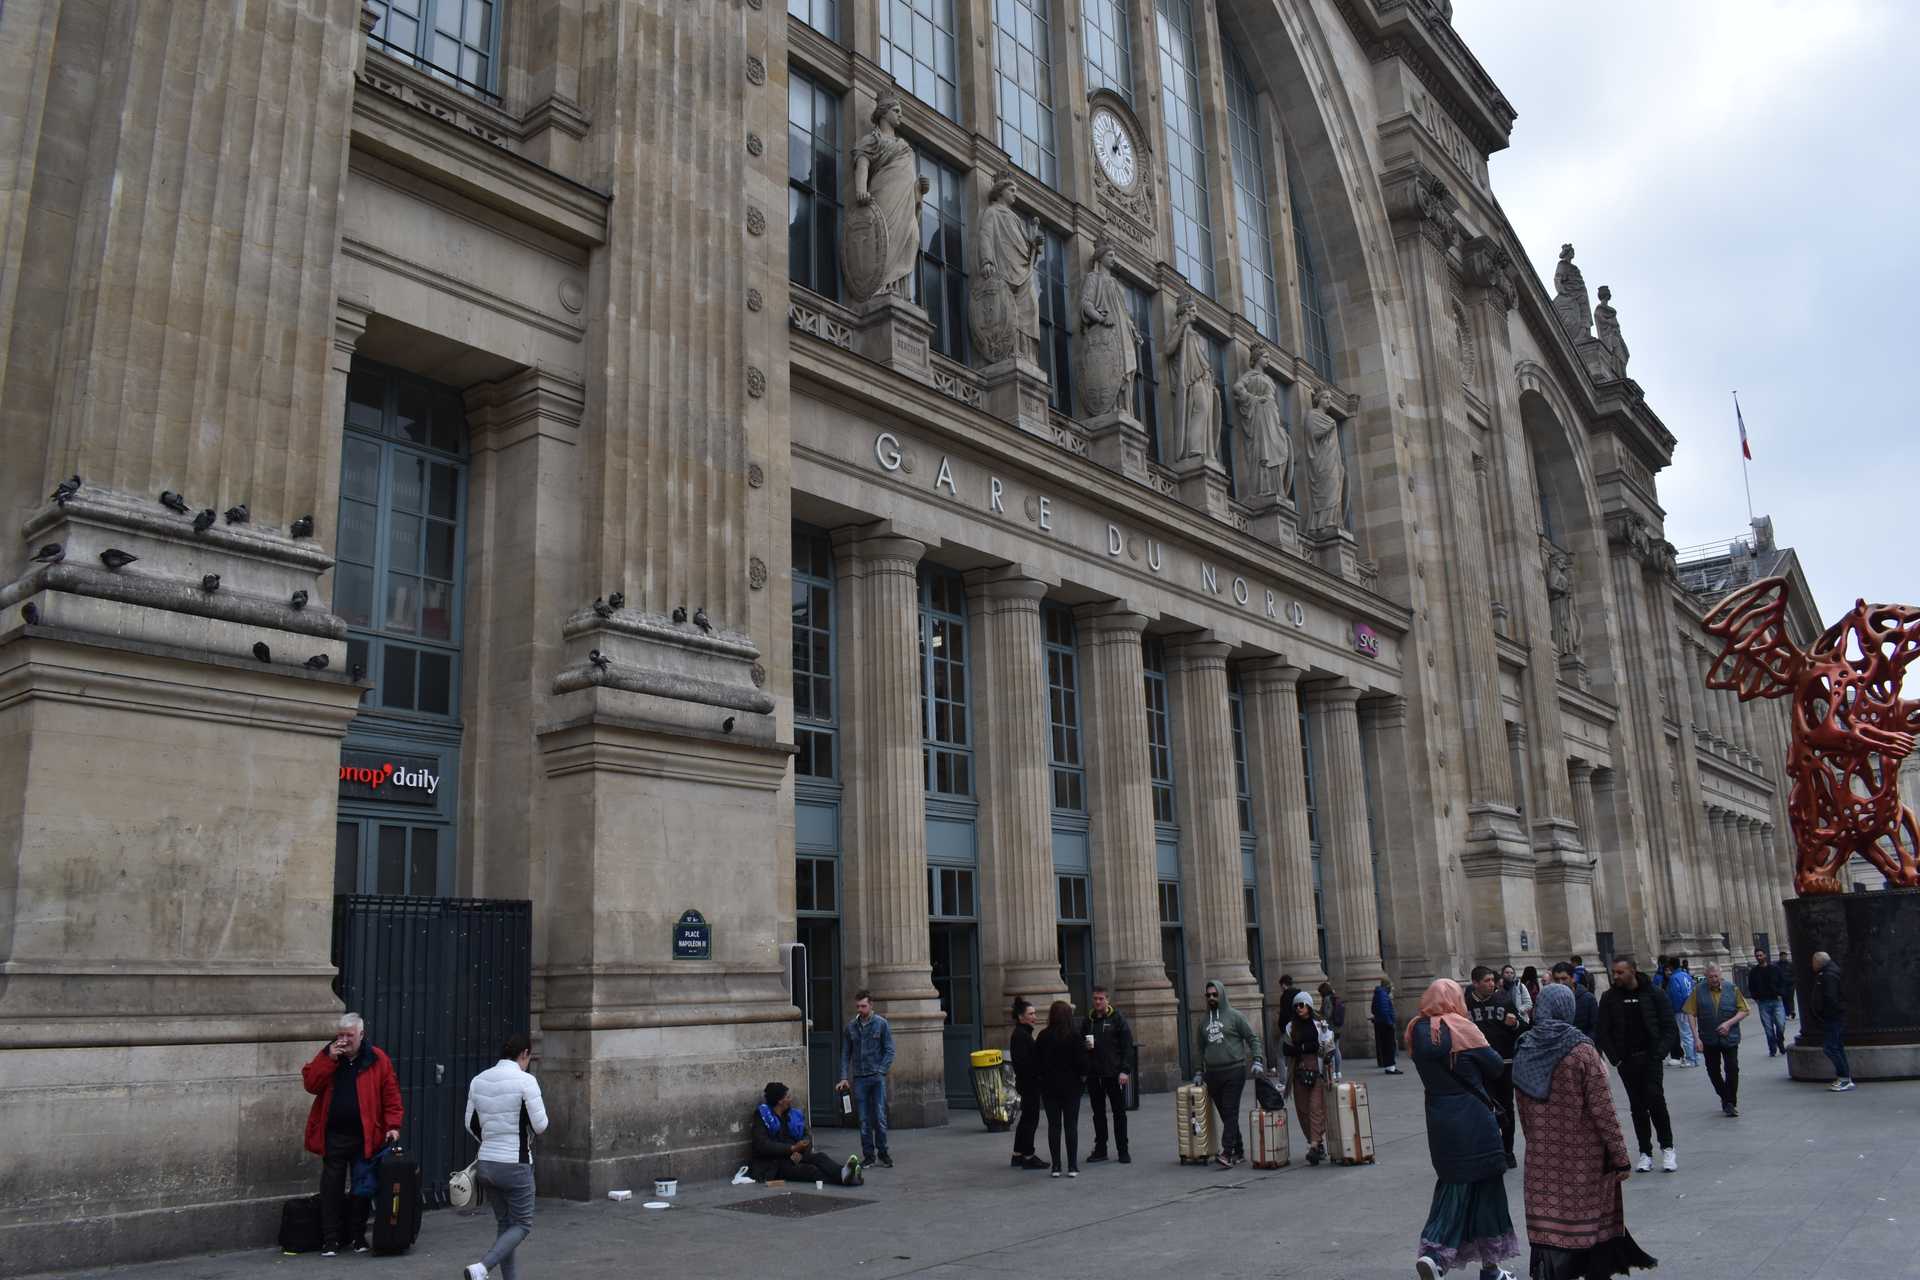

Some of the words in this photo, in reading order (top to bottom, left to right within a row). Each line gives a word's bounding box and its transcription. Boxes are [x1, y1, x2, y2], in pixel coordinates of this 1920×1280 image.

[876, 432, 1052, 531] GARE
[1108, 524, 1161, 572] DU
[1202, 562, 1304, 627] NORD
